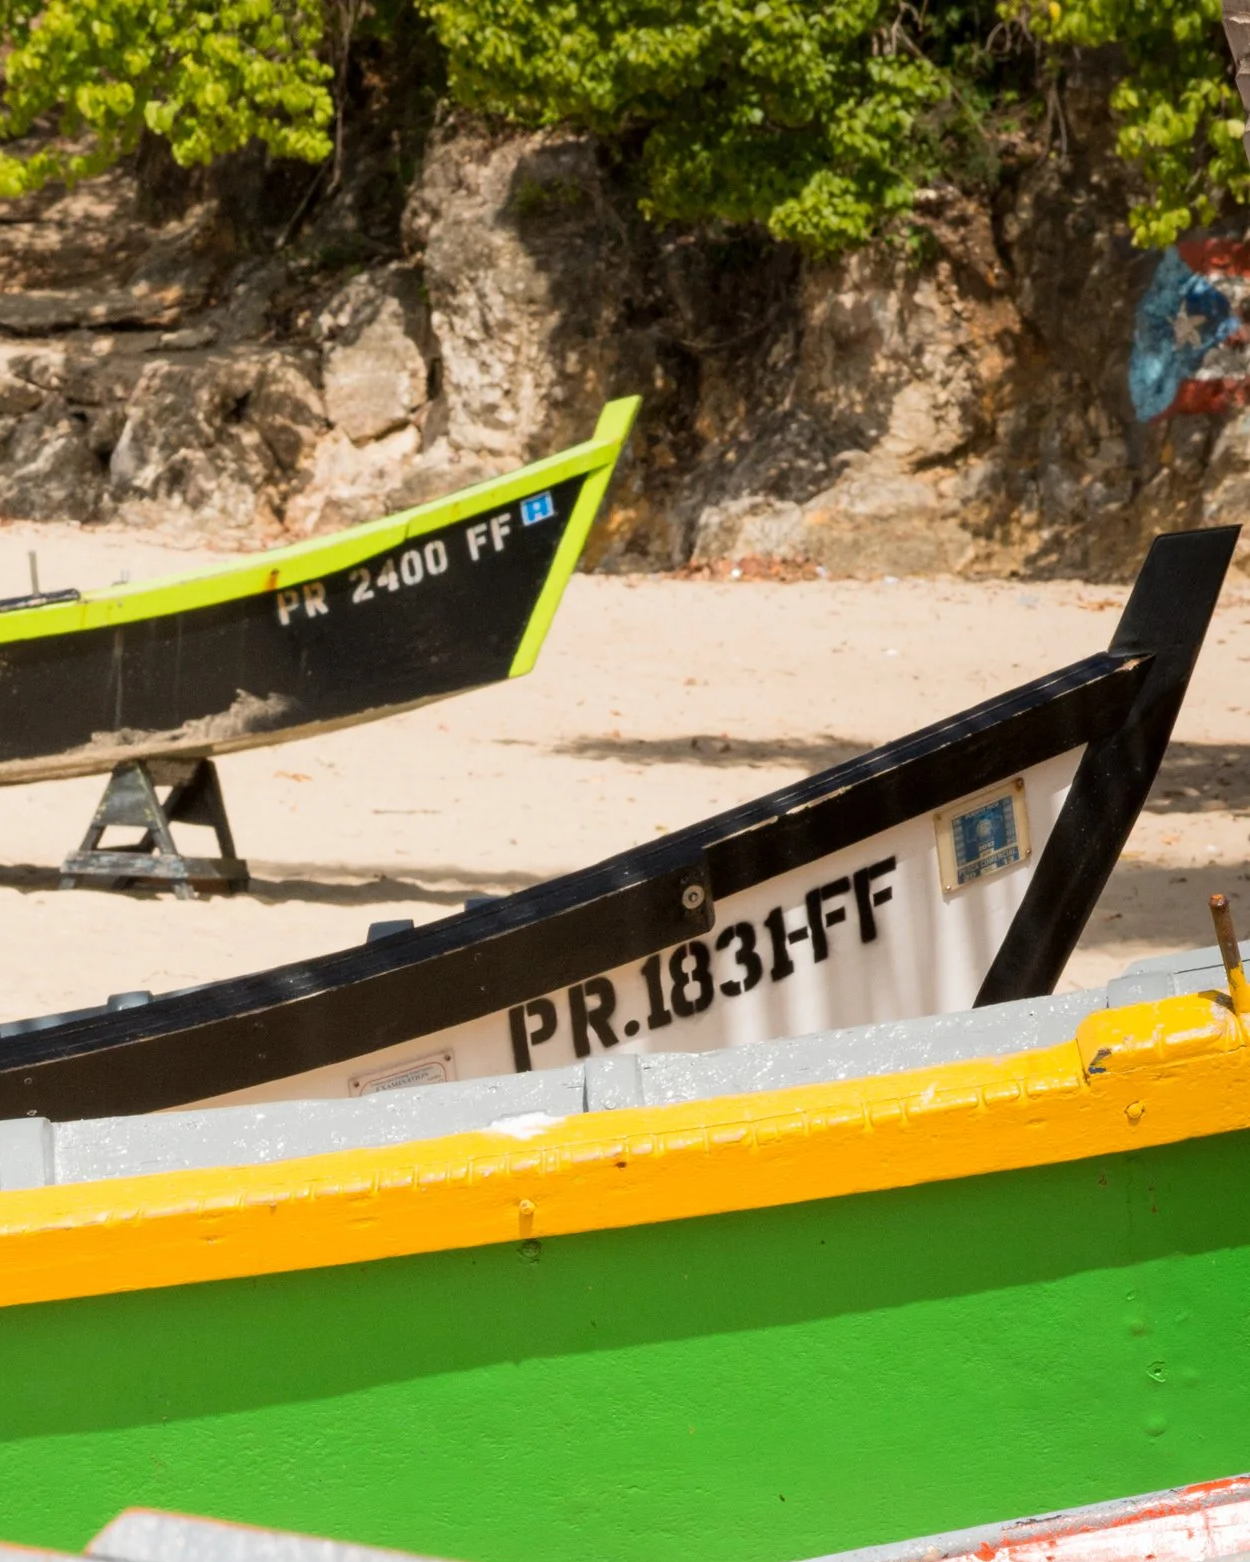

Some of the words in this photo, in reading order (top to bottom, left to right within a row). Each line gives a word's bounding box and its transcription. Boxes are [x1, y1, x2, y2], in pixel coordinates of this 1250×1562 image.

[276, 580, 329, 626] PR
[349, 539, 448, 604] 2400
[466, 512, 512, 562] FF
[376, 1072, 429, 1092] EXAMINATION
